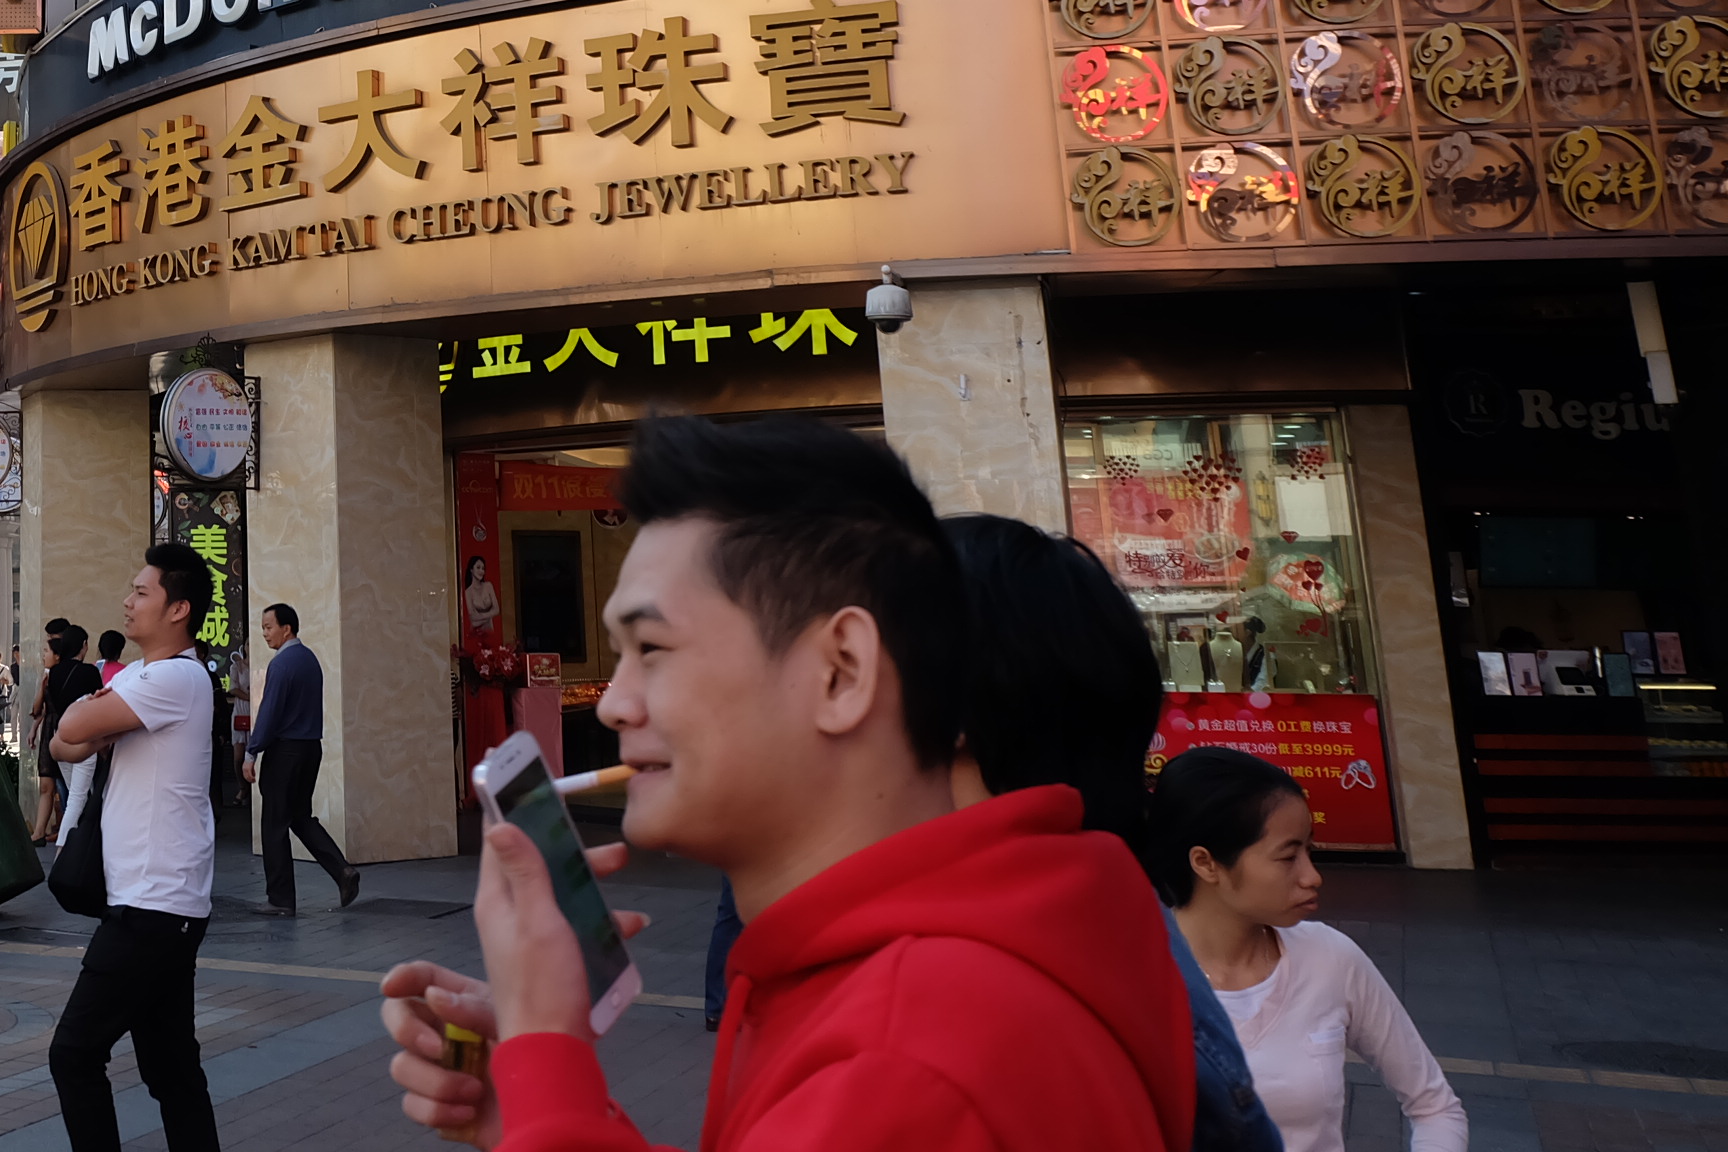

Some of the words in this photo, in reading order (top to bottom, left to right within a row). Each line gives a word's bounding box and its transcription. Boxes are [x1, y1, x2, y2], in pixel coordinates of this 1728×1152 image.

[71, 263, 130, 307] HONG
[138, 242, 214, 290] KONG
[386, 185, 574, 246] CHEUNG
[589, 151, 916, 225] JEWELLERY
